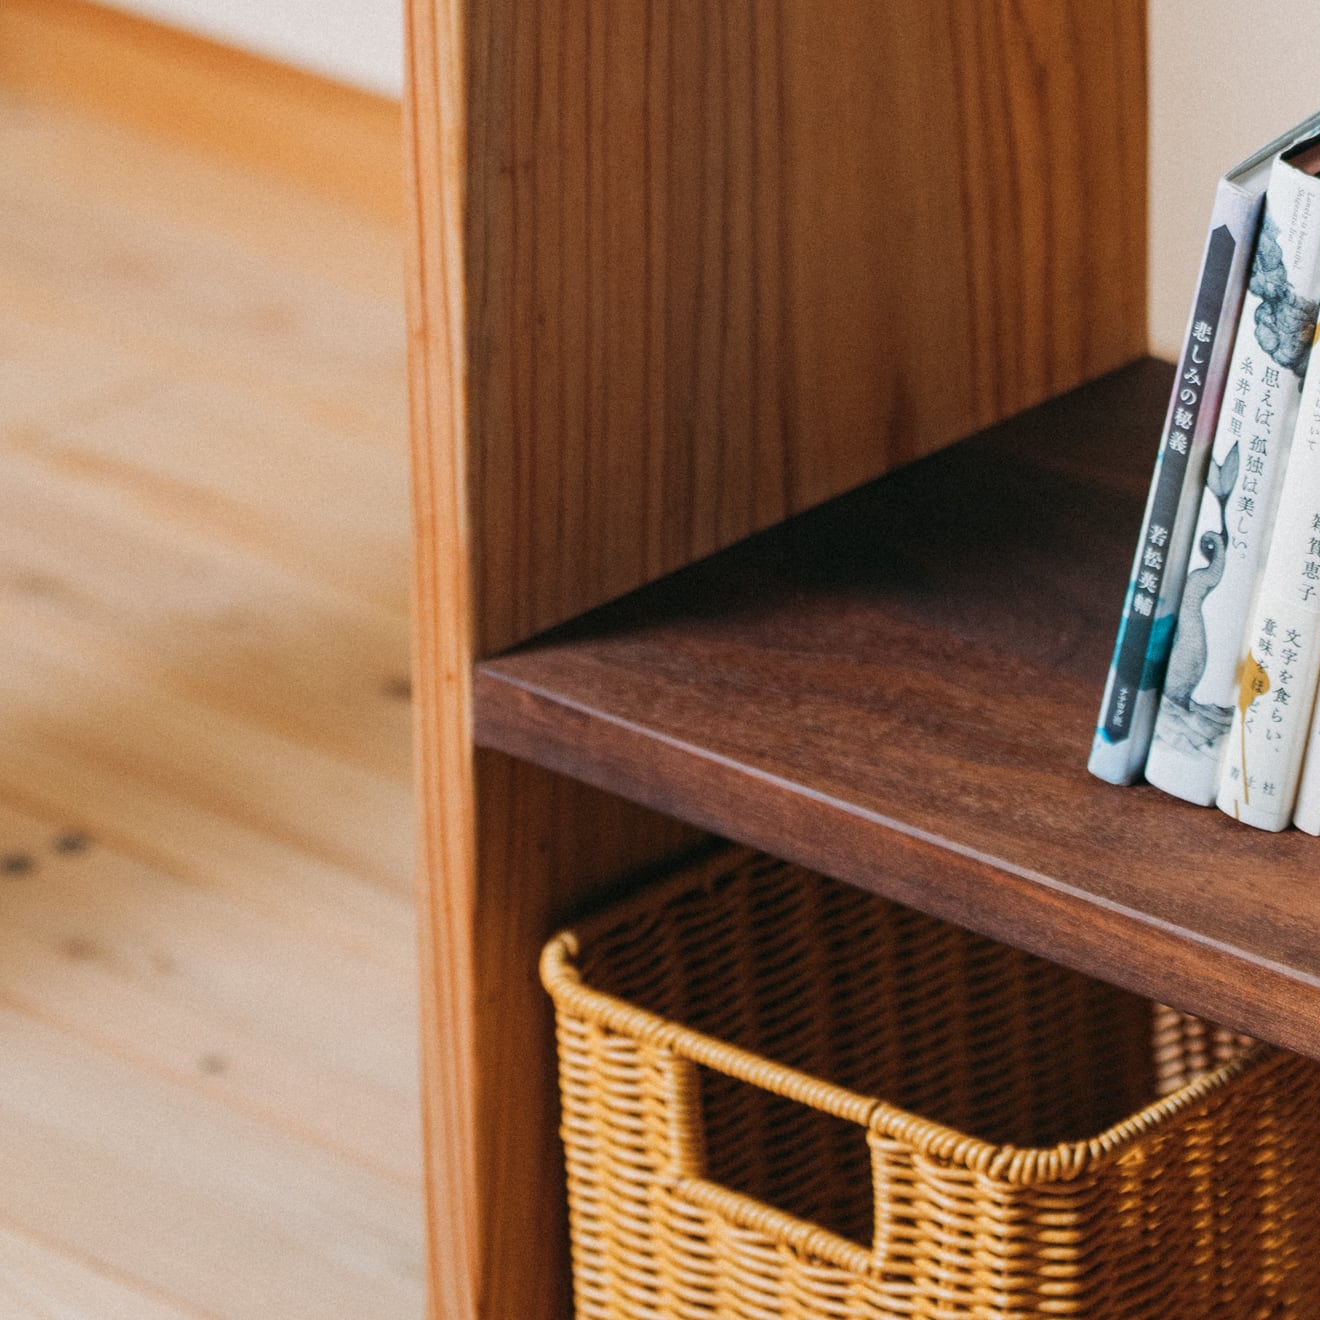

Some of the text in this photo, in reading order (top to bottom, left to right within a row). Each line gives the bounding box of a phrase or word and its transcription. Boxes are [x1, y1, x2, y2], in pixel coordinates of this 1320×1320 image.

[1168, 320, 1213, 456] 悲しみの秘義
[1229, 357, 1255, 437] 糸井重里
[1231, 366, 1280, 559] 思えば、孤独は美しい。
[1133, 524, 1168, 618] 若松英輔
